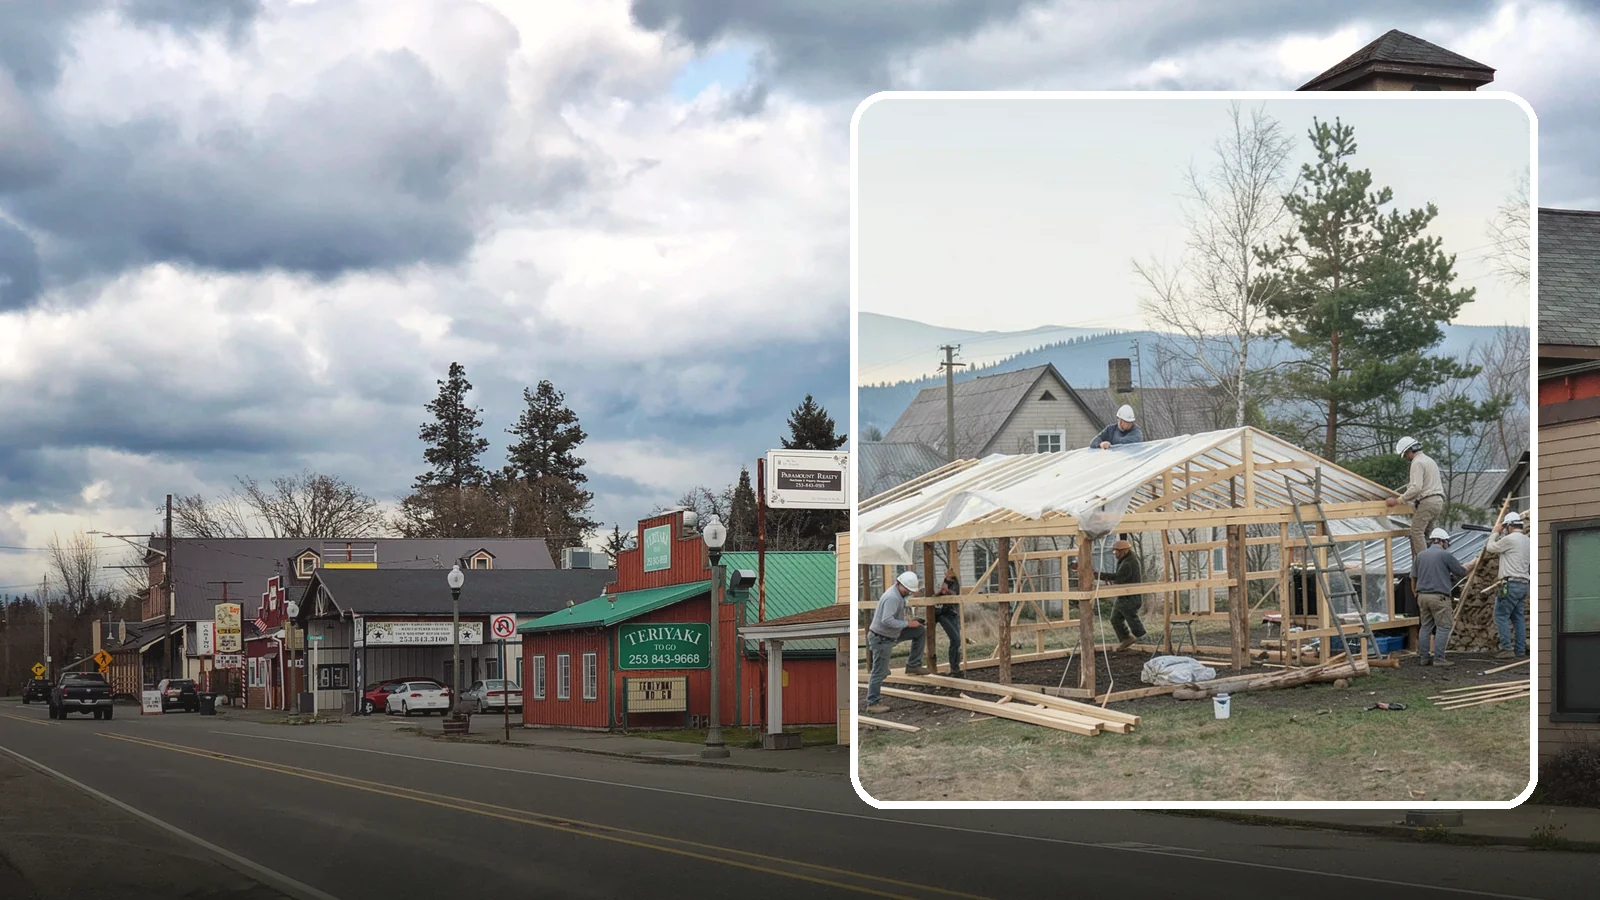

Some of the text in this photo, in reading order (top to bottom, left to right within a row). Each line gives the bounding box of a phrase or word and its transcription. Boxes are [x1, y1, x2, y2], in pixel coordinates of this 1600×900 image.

[781, 471, 815, 479] PARAMOUNT
[646, 531, 669, 549] TERIYAKI
[625, 627, 703, 646] TERIYAKI
[629, 653, 700, 665] 253 843-9668
